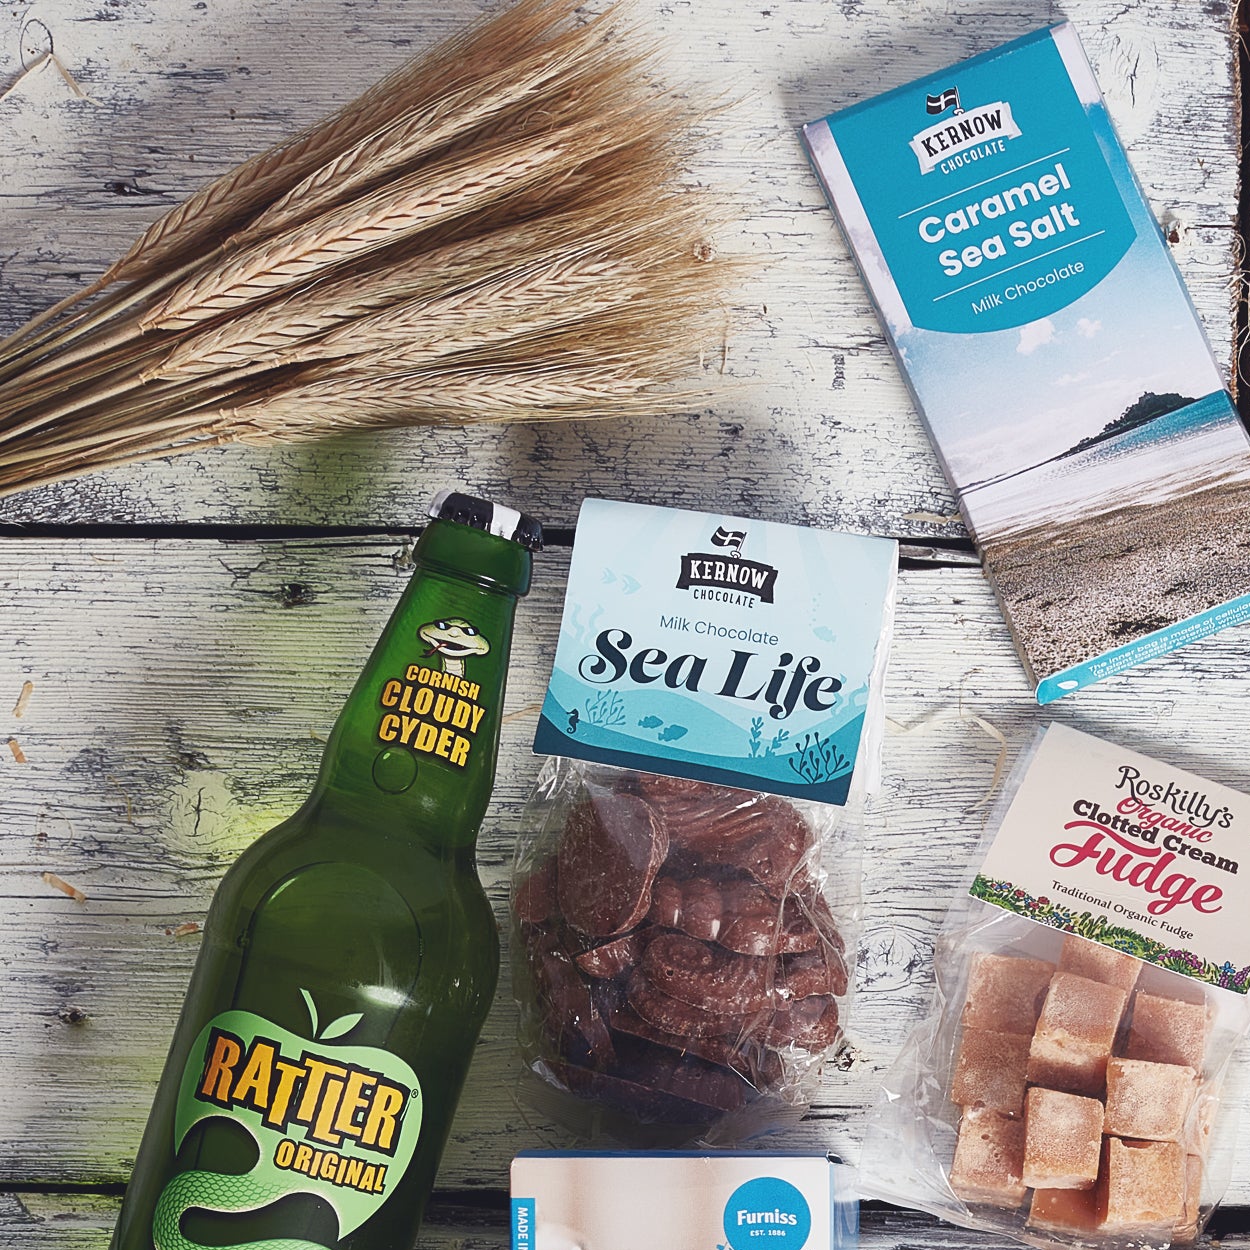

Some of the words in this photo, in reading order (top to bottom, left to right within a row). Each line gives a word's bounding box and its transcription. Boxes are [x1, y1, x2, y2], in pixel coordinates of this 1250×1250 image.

[921, 109, 1002, 158] KERNOW
[940, 139, 1006, 175] CHOCOLATE
[918, 163, 1071, 243] Caramel
[938, 235, 1007, 277] Sea
[1008, 202, 1080, 248] Salt
[971, 293, 1003, 315] Milk
[1004, 261, 1085, 301] Chocolate
[690, 559, 768, 590] KERNOW
[693, 588, 755, 609] CHOCOLATE
[659, 614, 690, 633] Milk
[694, 620, 779, 646] Chocolate
[405, 664, 480, 700] CORNISH
[578, 628, 708, 693] Sea
[714, 649, 842, 720] Life
[381, 680, 486, 734] CLOUDY
[378, 713, 471, 767] CYDER
[1073, 799, 1160, 845] Clotted
[1163, 834, 1239, 875] Cream
[1116, 797, 1213, 843] Organic
[1049, 820, 1224, 916] Fudge
[1051, 880, 1112, 910] Traditional
[1113, 902, 1158, 928] Organic
[1159, 920, 1194, 941] Fudge
[199, 1031, 408, 1153] RATTLER
[274, 1141, 387, 1194] ORIGINAL
[517, 1207, 529, 1240] MADE
[736, 1208, 798, 1226] Furniss
